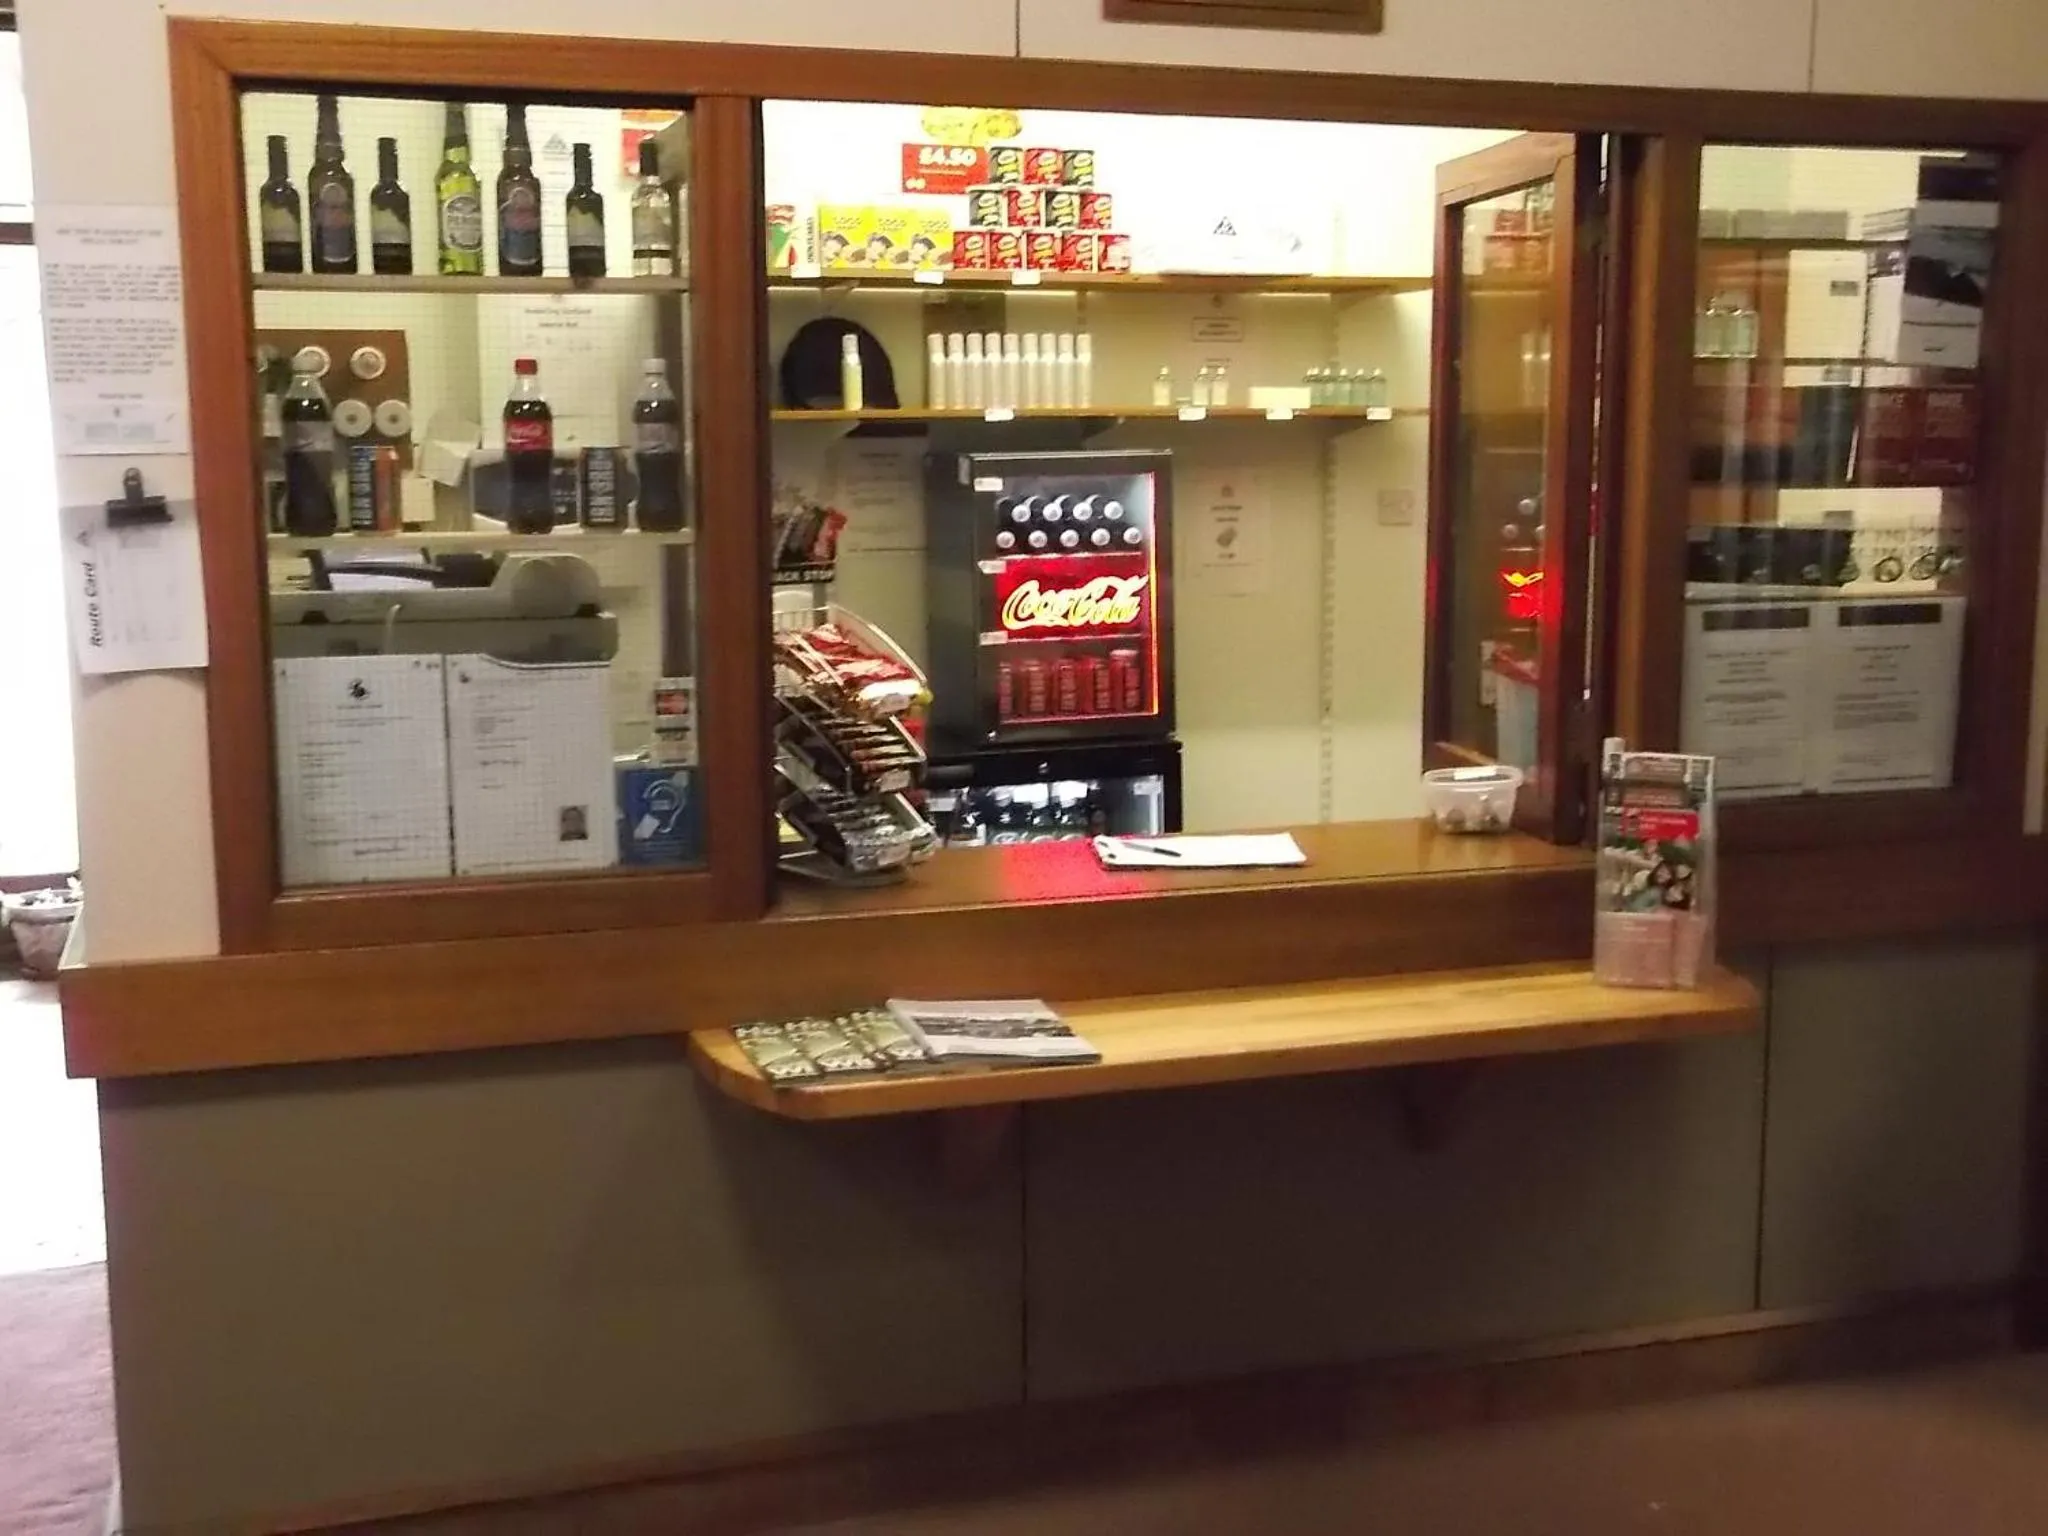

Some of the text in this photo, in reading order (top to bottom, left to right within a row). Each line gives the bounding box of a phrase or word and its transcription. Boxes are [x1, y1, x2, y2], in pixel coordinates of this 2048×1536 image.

[919, 146, 977, 167] £4.50
[81, 561, 104, 646] Route Card
[1002, 575, 1149, 630] Coca-Cola
